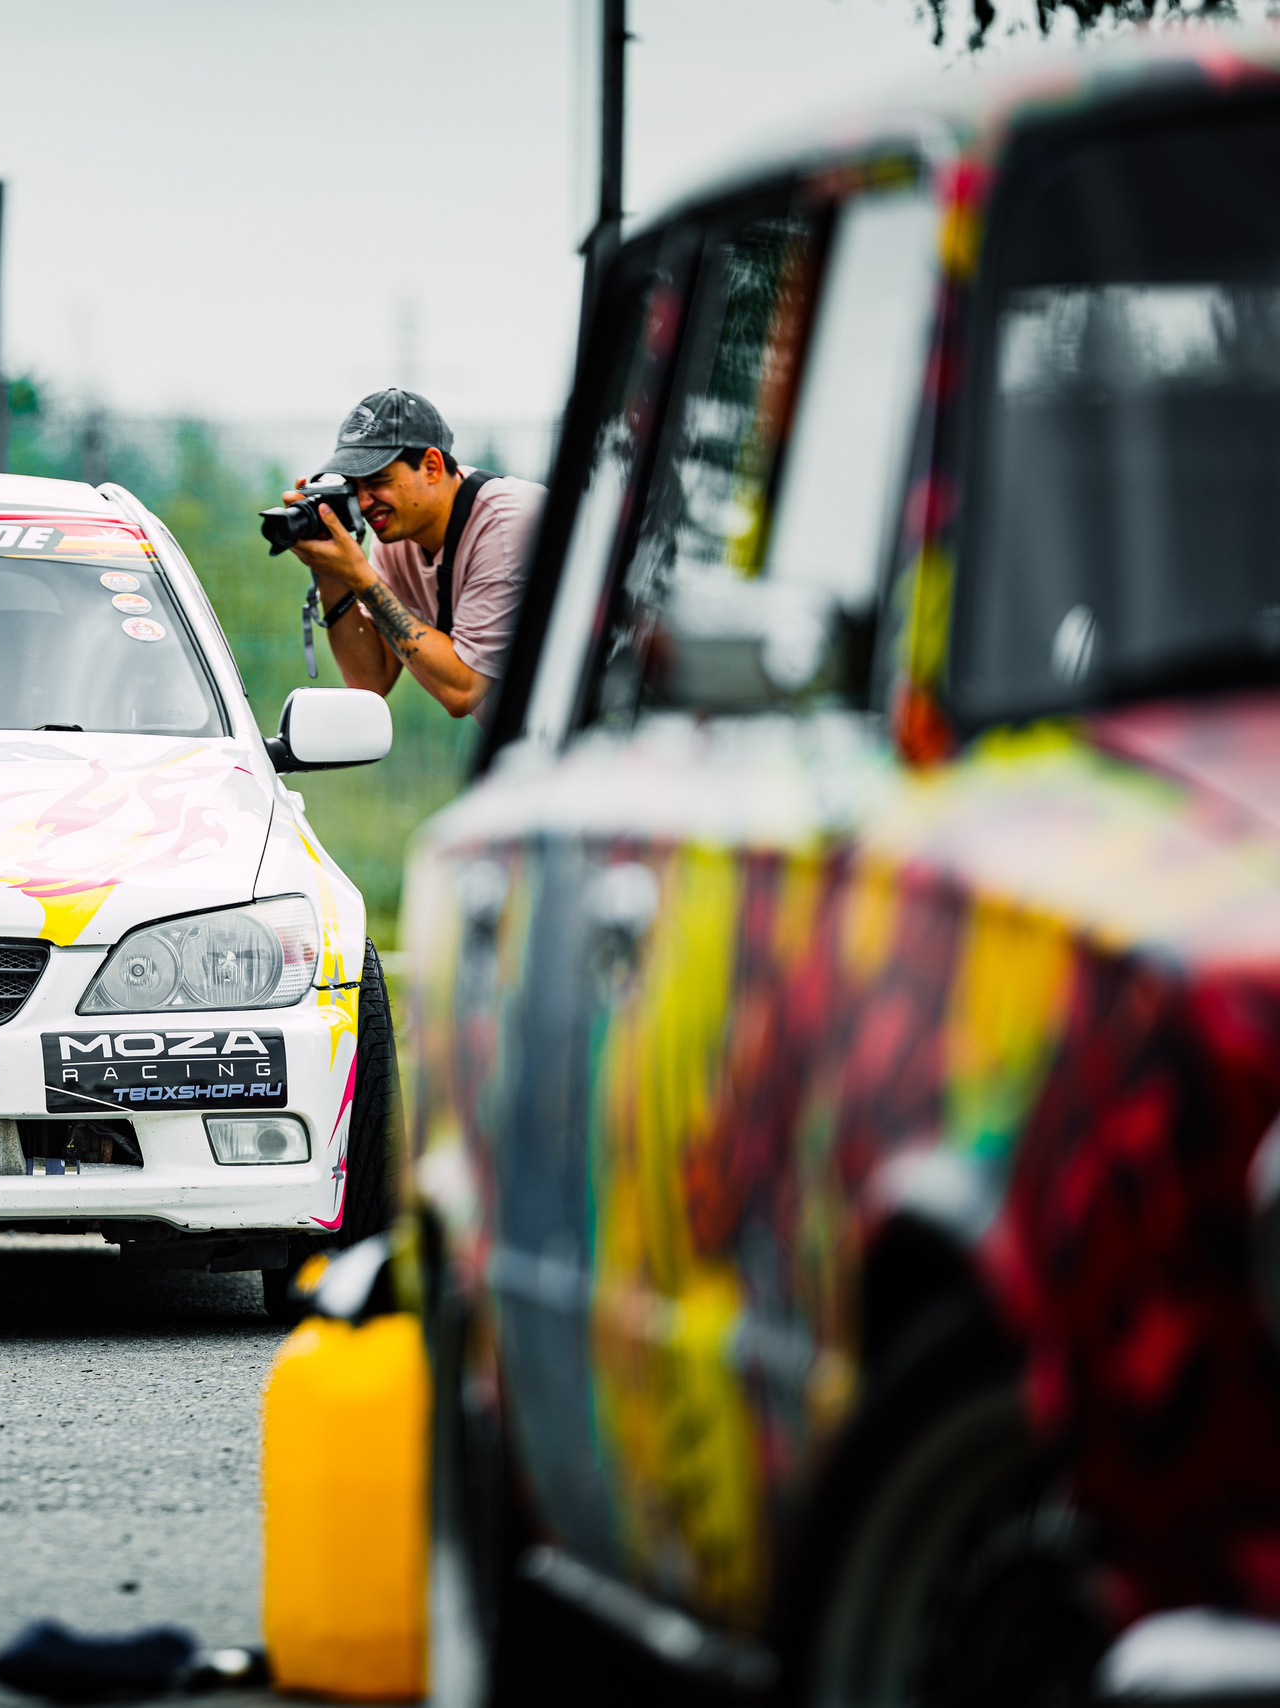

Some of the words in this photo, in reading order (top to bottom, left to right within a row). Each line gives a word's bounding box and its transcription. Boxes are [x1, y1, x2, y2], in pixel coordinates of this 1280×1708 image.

[58, 1031, 269, 1060] MOZA
[62, 1062, 270, 1082] RACING
[113, 1082, 282, 1101] TBOXSHOP.RU
